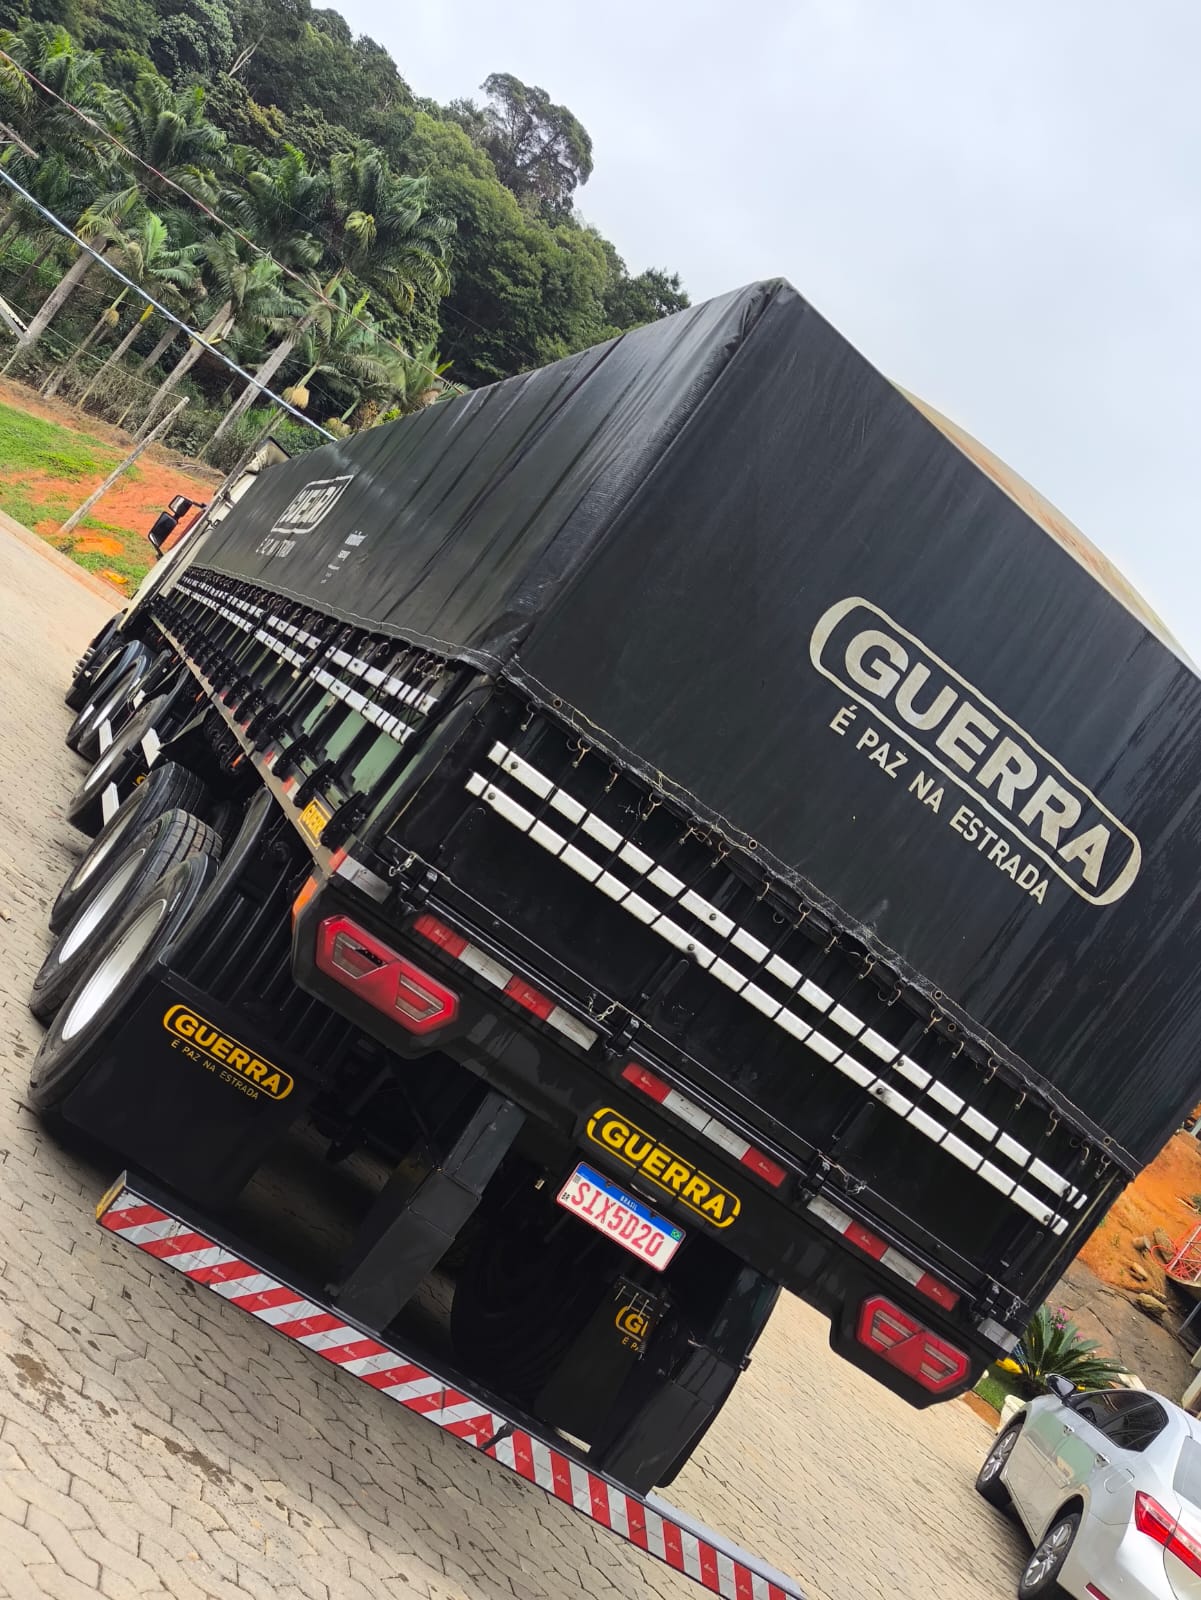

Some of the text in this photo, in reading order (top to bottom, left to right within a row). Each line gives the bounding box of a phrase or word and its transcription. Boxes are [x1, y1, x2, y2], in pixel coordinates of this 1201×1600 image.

[845, 630, 1110, 887] GUERRA
[829, 705, 1049, 905] É PAZ NA ESTRADA
[170, 1038, 259, 1100] É PAZ NA ESTRADA
[174, 1014, 281, 1094] GUERRA
[601, 1120, 728, 1220] GUERRA
[620, 1194, 637, 1211] BRASIL
[570, 1181, 665, 1258] SIX5D20
